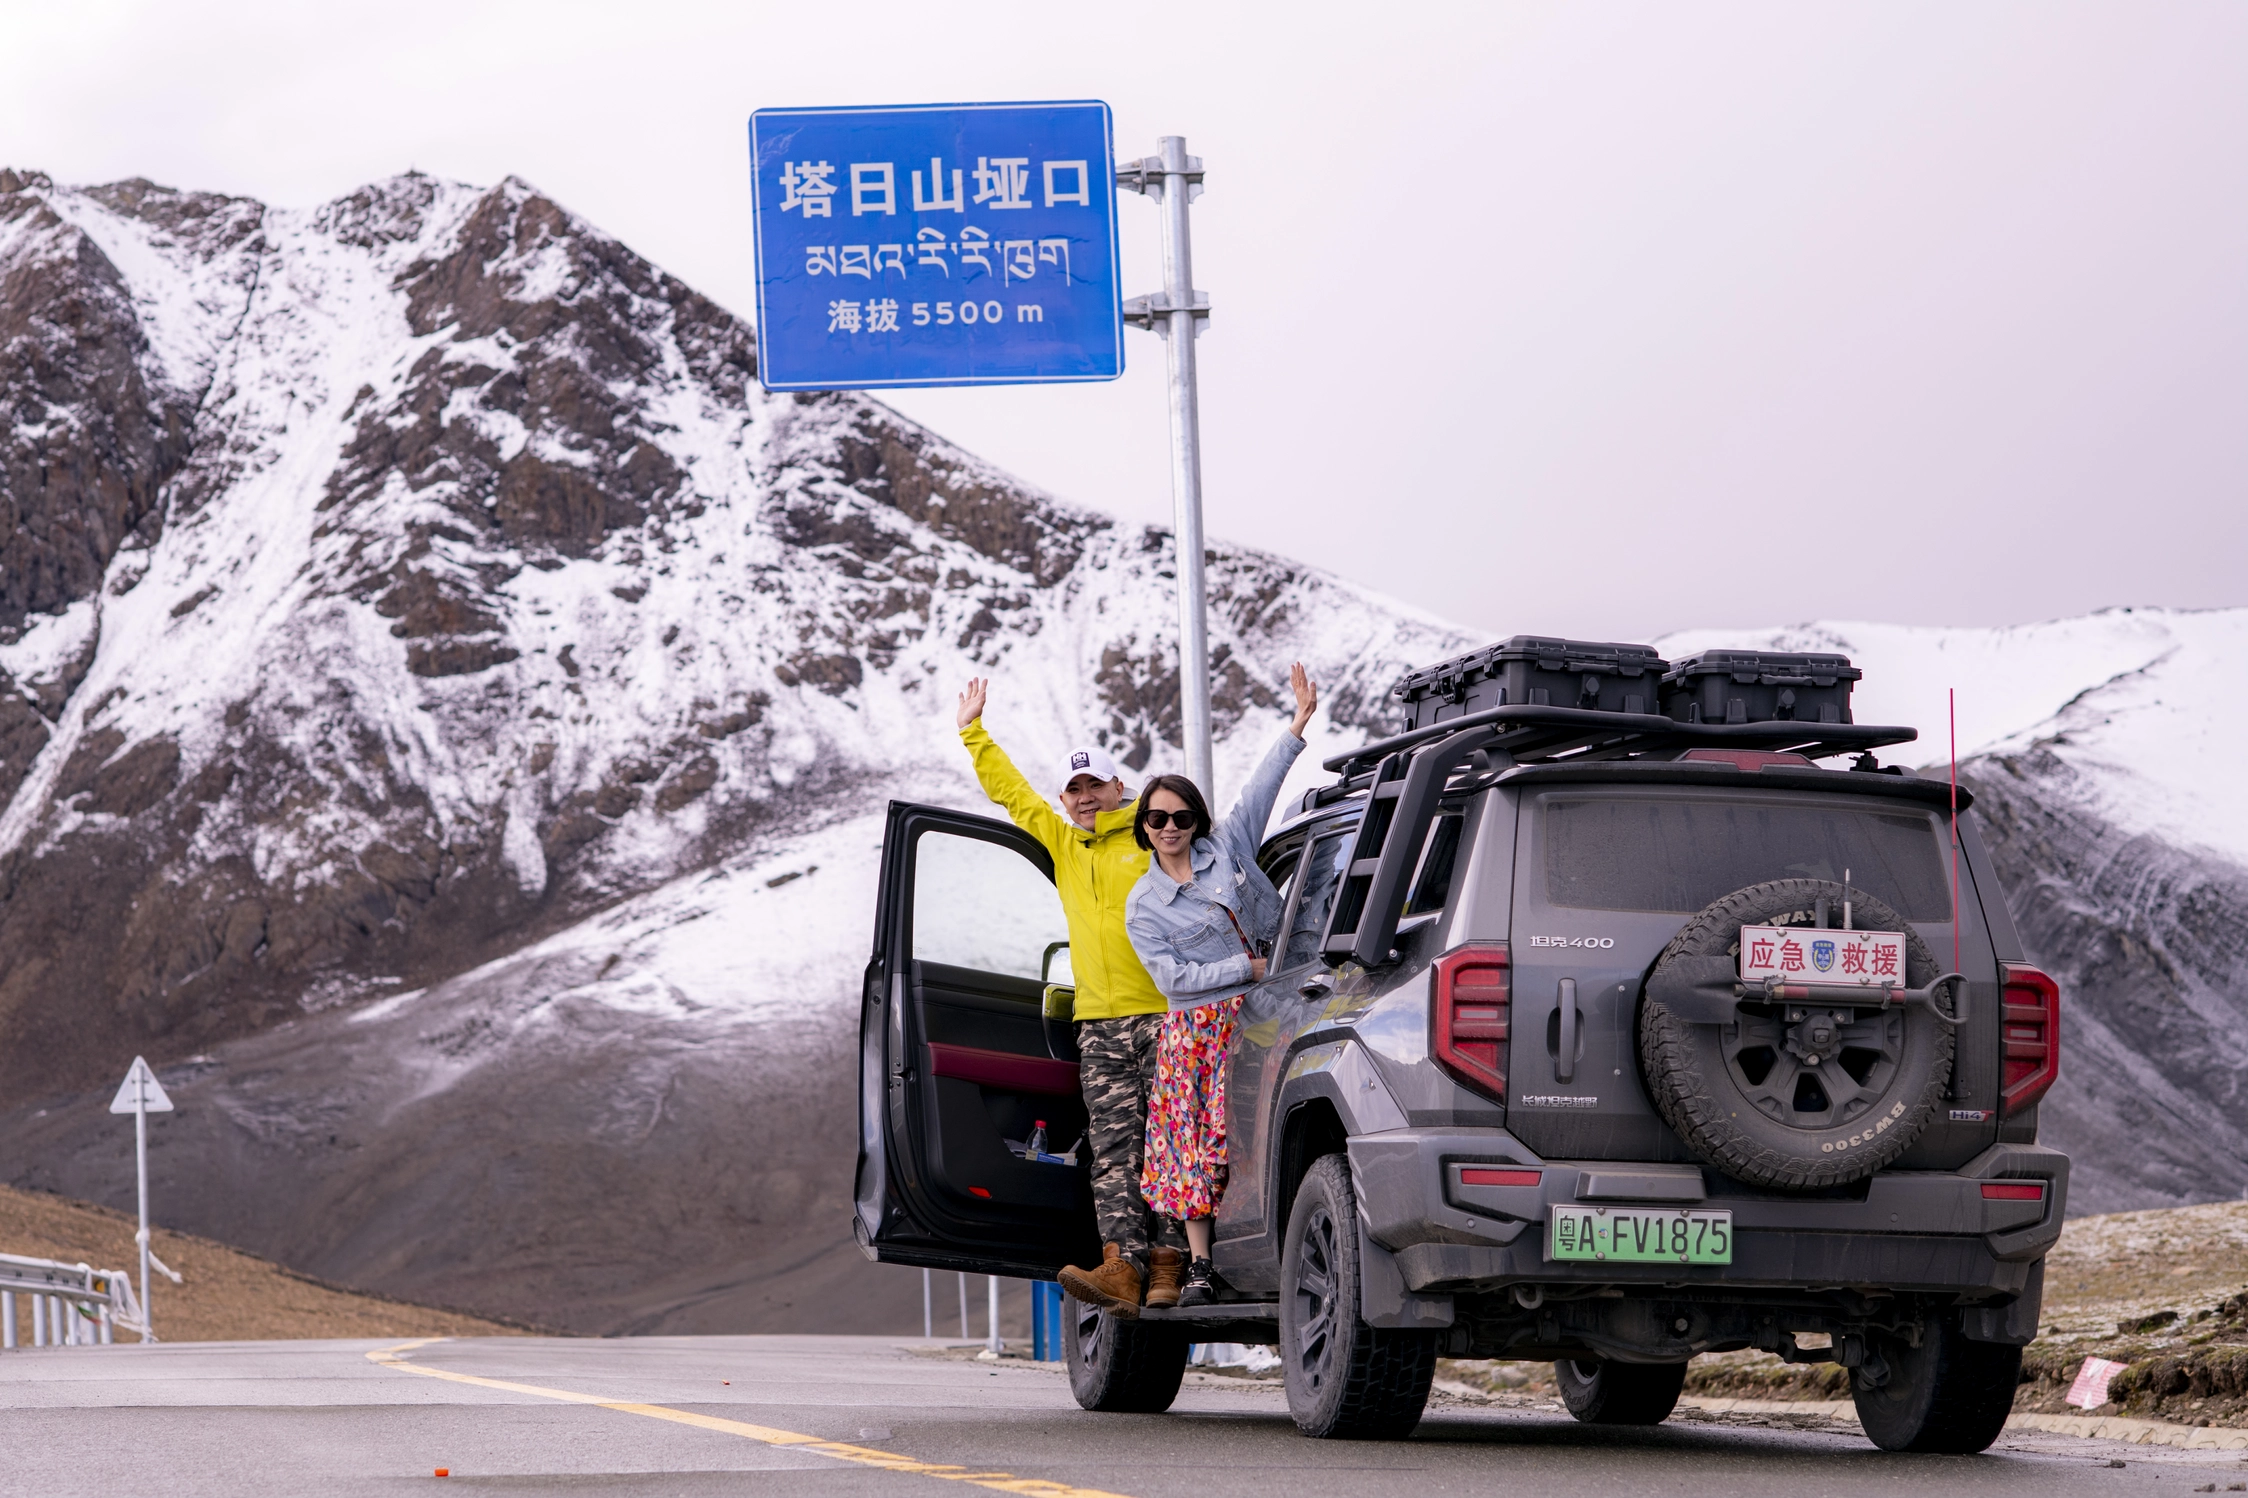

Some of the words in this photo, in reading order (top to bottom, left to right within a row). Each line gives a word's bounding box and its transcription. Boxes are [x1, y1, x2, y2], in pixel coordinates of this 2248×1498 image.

[779, 157, 1090, 218] 塔日山垭口
[828, 298, 900, 334] 海拔
[912, 300, 1003, 325] 5500
[1017, 304, 1043, 322] m
[1530, 936, 1614, 949] 坦克400
[1748, 937, 1806, 973] 应急
[1841, 942, 1898, 977] 救援
[1821, 1101, 1907, 1153] BW3300
